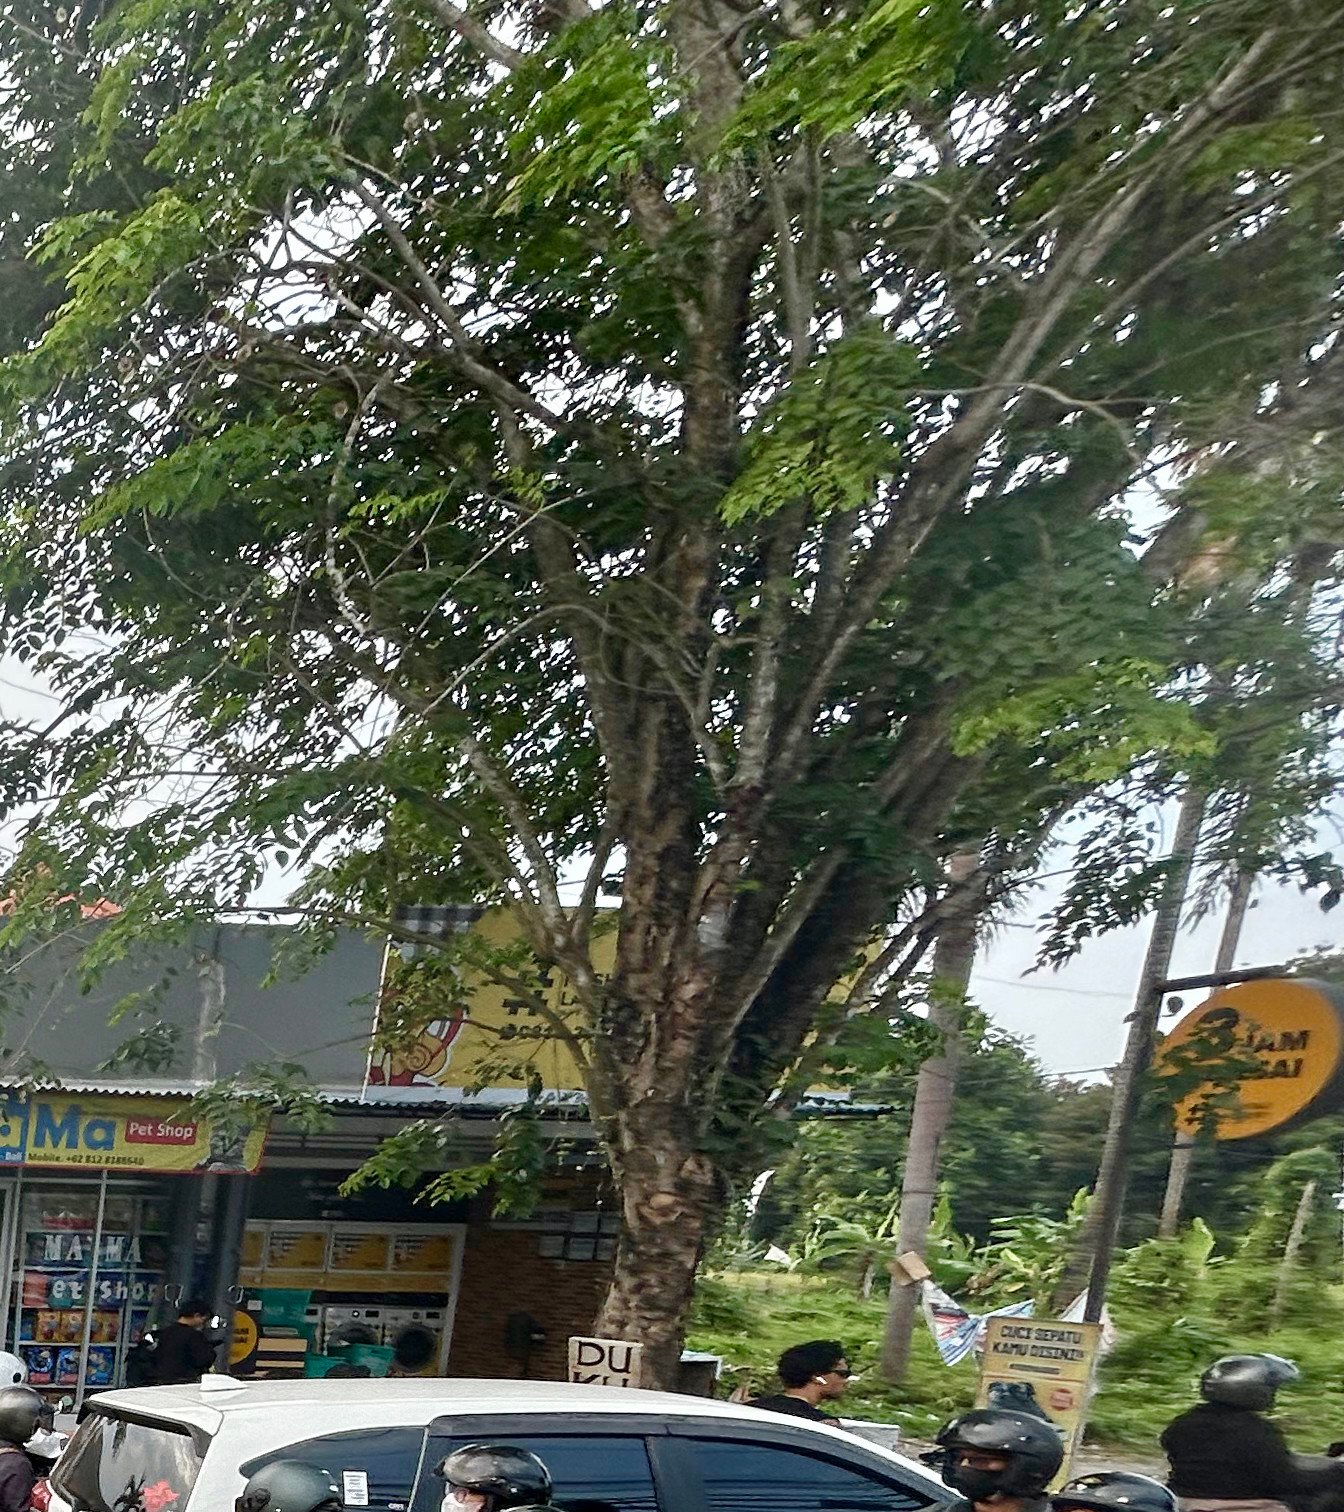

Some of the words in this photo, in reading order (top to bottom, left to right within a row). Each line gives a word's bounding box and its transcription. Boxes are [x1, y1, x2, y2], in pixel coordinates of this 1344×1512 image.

[129, 1122, 154, 1135] Pet
[157, 1122, 193, 1139] Shop
[44, 1234, 83, 1261] MA
[104, 1235, 142, 1263] MA
[577, 1341, 633, 1374] DU
